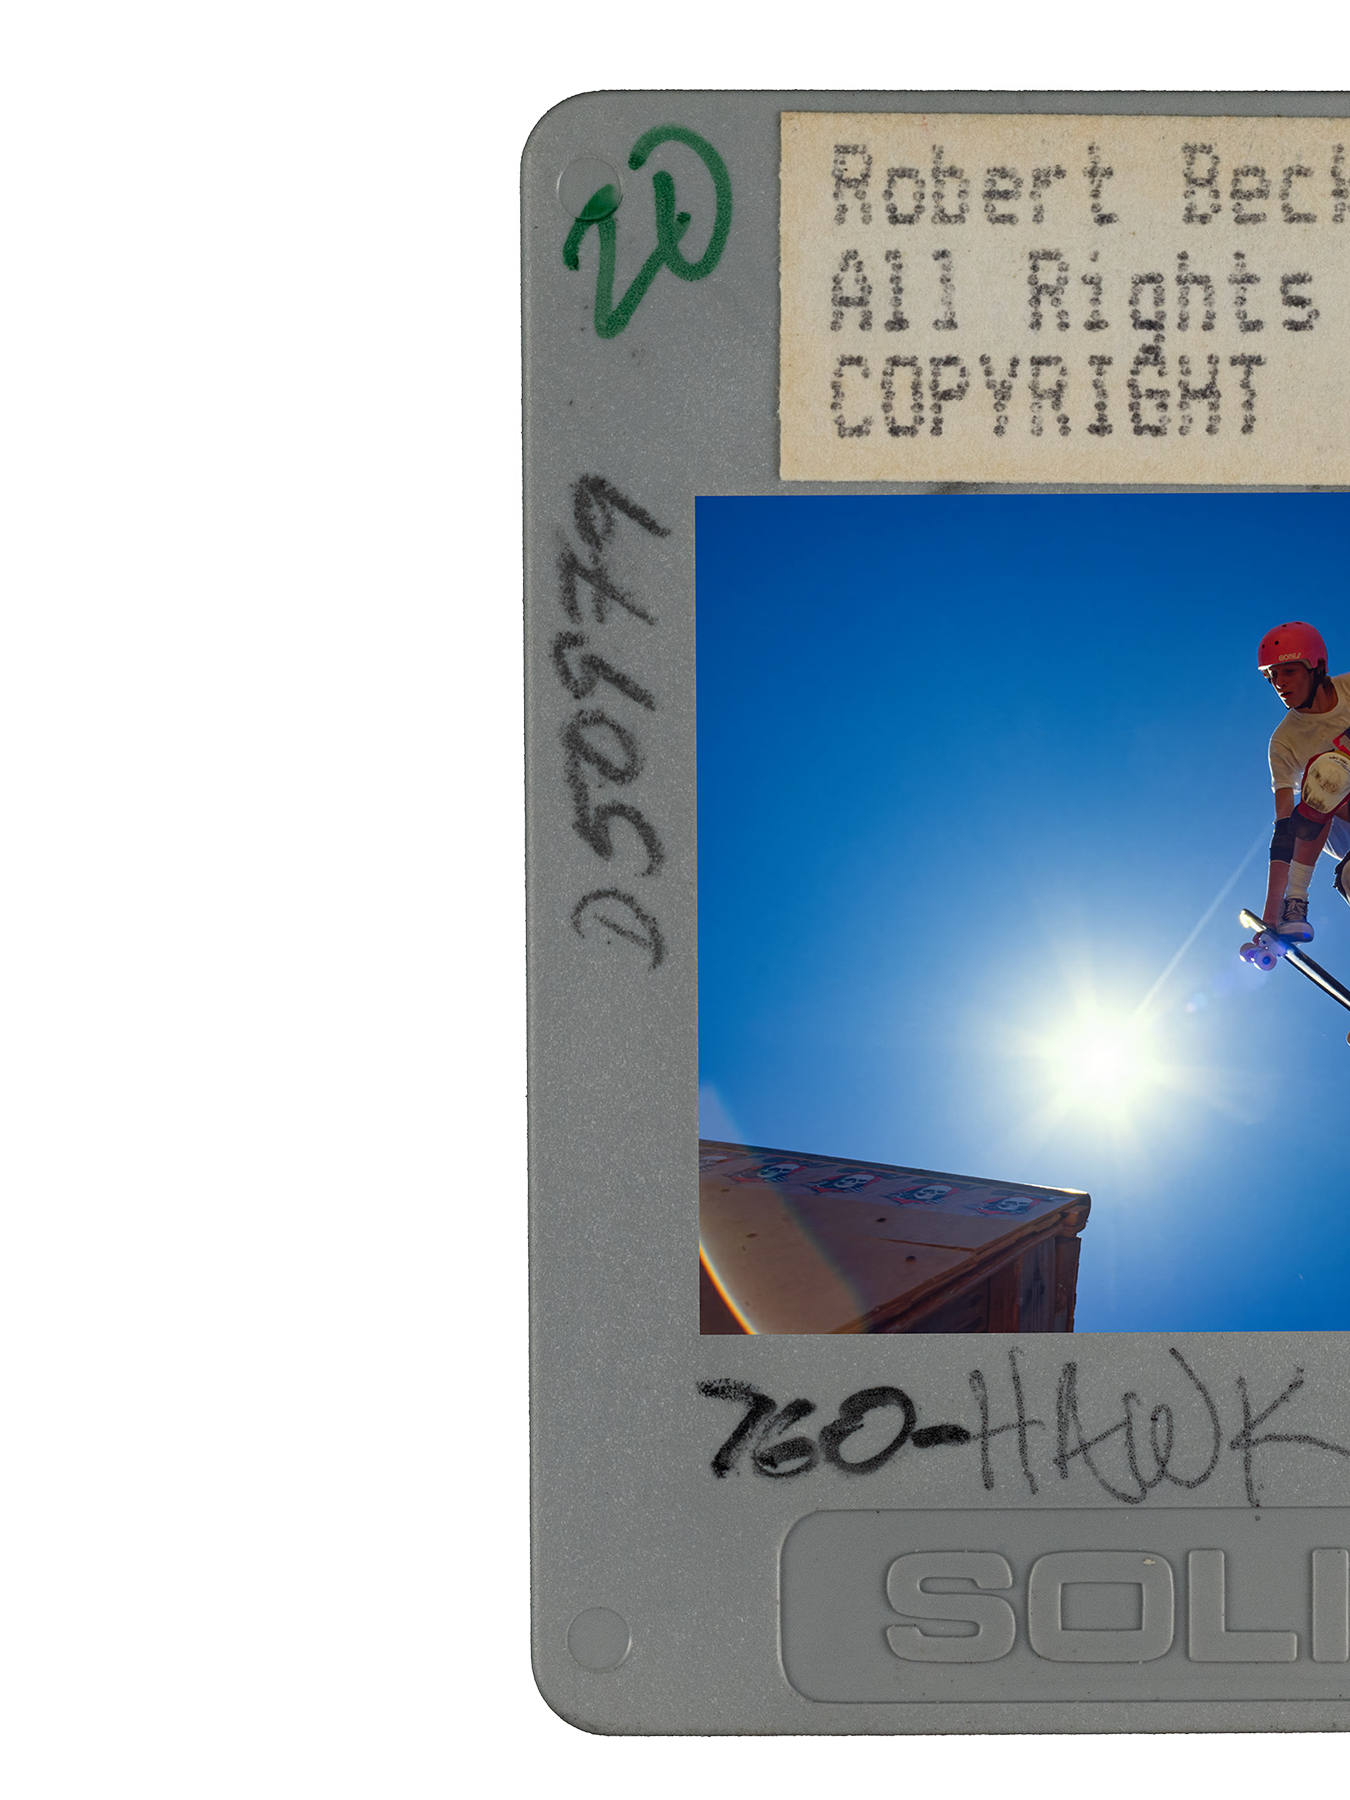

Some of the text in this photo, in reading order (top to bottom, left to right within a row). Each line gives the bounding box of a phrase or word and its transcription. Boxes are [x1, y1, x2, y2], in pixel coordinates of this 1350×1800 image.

[832, 142, 1118, 226] Robert
[830, 248, 959, 333] All
[1027, 249, 1320, 364] Rights
[830, 353, 1266, 438] COPYRIGHT
